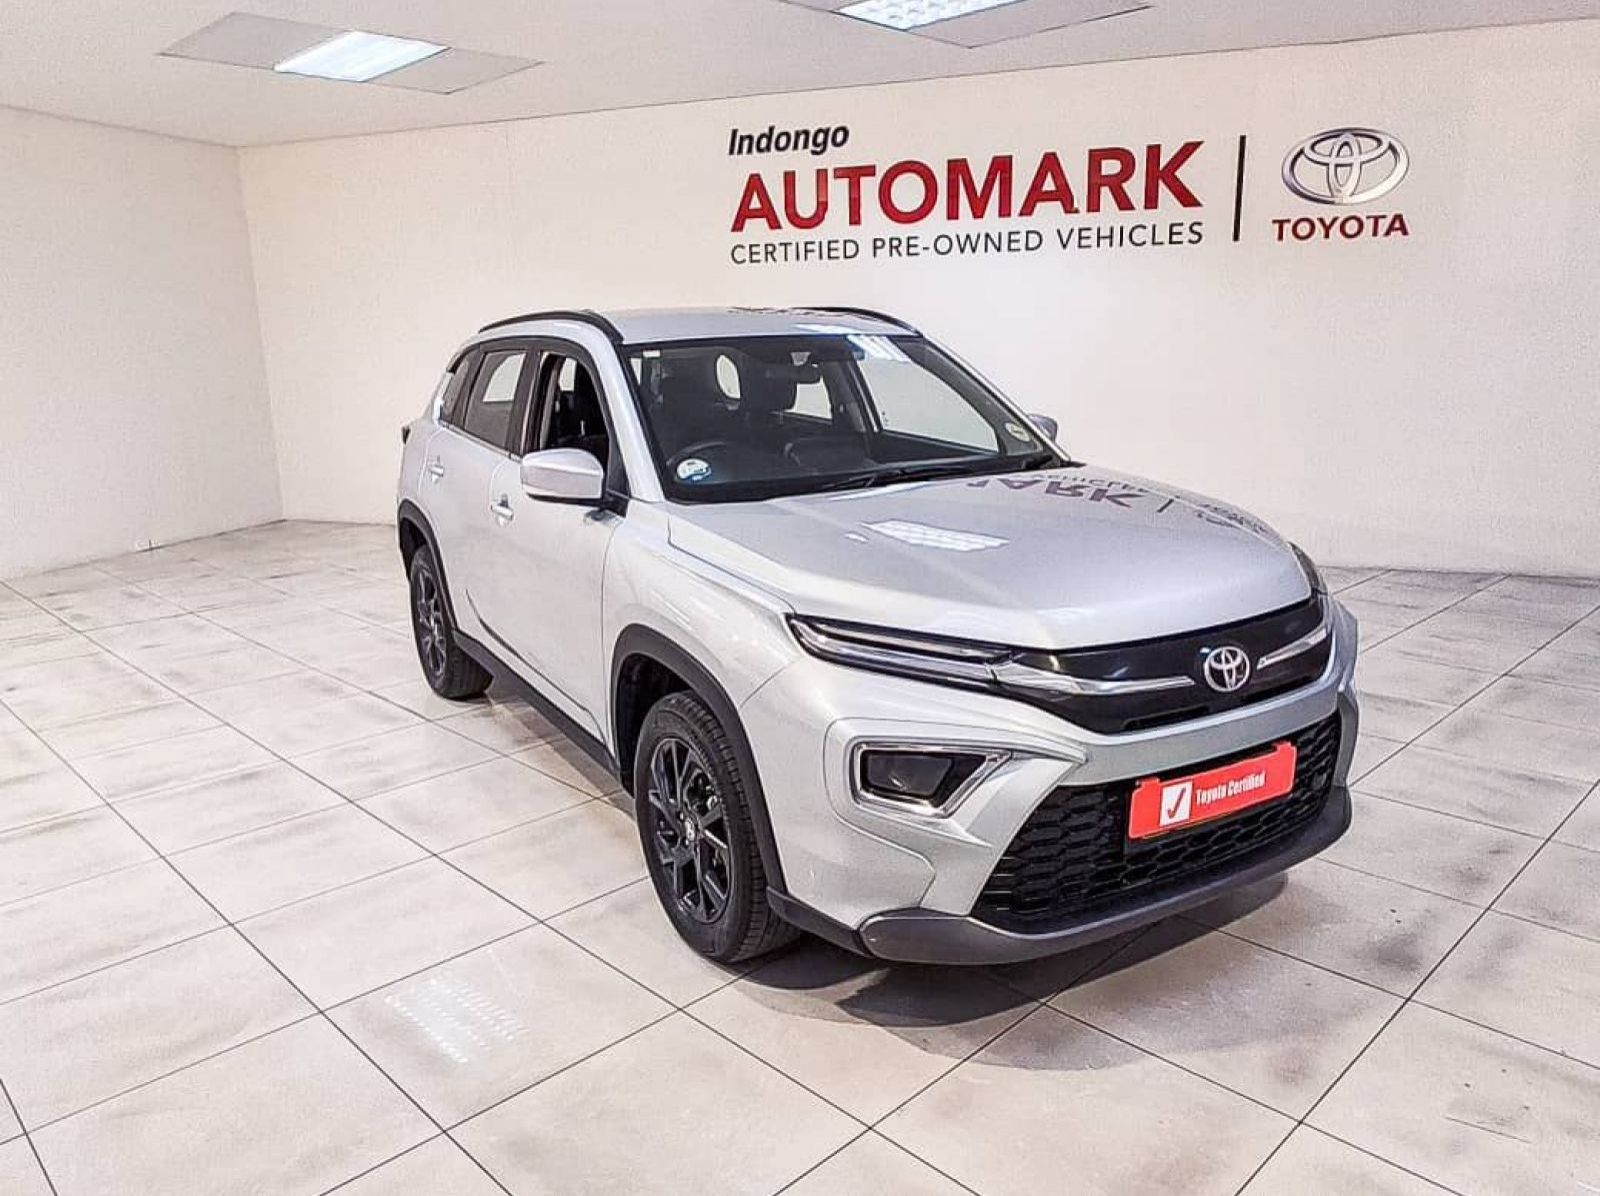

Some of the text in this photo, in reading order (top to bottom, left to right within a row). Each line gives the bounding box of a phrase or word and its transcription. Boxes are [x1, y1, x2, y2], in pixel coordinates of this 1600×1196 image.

[728, 125, 850, 156] Indongo
[730, 140, 1205, 233] AUTOMARK
[730, 221, 1204, 265] CERTIFIED PRE-OWNED VEHICLES
[1272, 213, 1409, 242] TOYOTA
[1196, 769, 1267, 807] Toyota Certified
